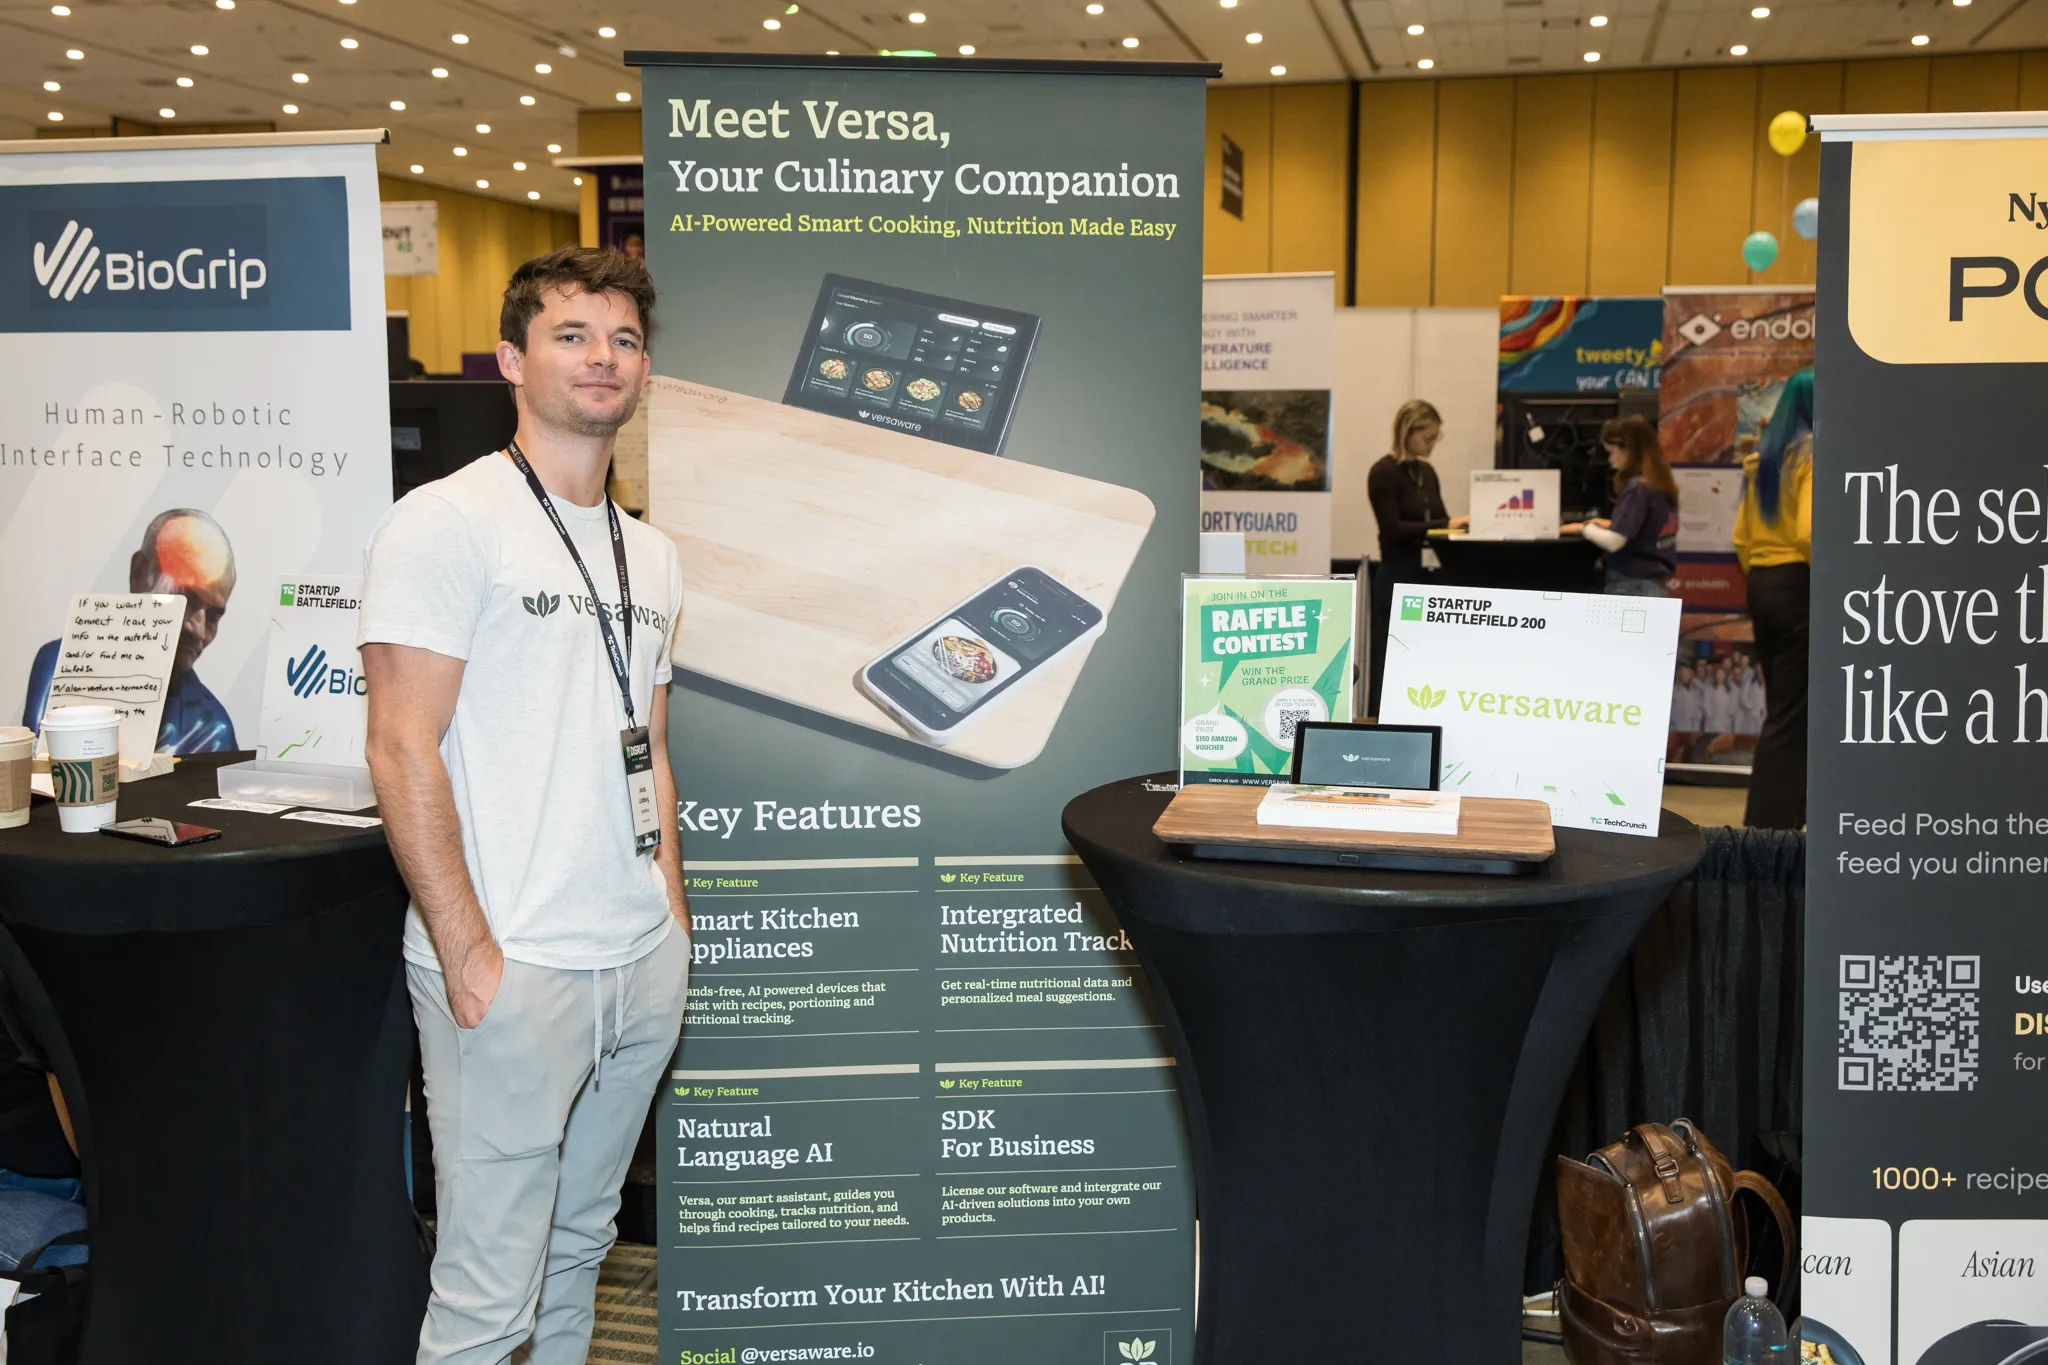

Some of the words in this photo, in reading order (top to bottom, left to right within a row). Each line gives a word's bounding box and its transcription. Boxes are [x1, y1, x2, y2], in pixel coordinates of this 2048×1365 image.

[669, 99, 789, 138] Meet
[803, 101, 949, 148] Versa,
[669, 161, 763, 192] Your
[775, 158, 944, 202] Culinary
[955, 163, 1179, 203] Companion
[670, 213, 792, 231] AI-Powered
[799, 215, 863, 232] Smart
[869, 215, 960, 238] Cooking,
[967, 216, 1064, 234] Nutrition
[1070, 217, 1124, 235] Made
[1130, 219, 1176, 240] Easy
[106, 248, 266, 299] BioGrip
[871, 413, 921, 432] versaware
[0, 443, 142, 467] Interface
[162, 444, 348, 476] Technology
[1845, 464, 1960, 545] The
[298, 585, 340, 595] STARTUP
[1212, 593, 1233, 601] JOIN
[1251, 590, 1264, 599] ON
[1268, 589, 1287, 597] THE
[116, 599, 143, 609] want
[152, 600, 162, 608] to
[297, 597, 356, 609] BATTLEFIELD
[1428, 597, 1492, 611] STARTUP
[1842, 574, 1998, 646] stove
[123, 616, 146, 626] leave
[152, 619, 173, 627] your
[1212, 606, 1306, 632] RAFFLE
[1426, 611, 1518, 628] BATTLEFIELD
[1521, 617, 1546, 630] 200
[107, 633, 118, 641] the
[1213, 632, 1307, 654] CONTEST
[1242, 667, 1262, 676] WIN
[1265, 667, 1285, 675] THE
[1242, 677, 1277, 686] GRAND
[1280, 675, 1309, 685] PRIZE
[1457, 690, 1642, 726] versaware
[1840, 664, 1948, 745] like
[1965, 688, 1998, 746] a
[1196, 735, 1209, 743] $150
[677, 800, 743, 839] Key
[754, 799, 921, 832] Features
[1604, 818, 1647, 830] TechCrunch
[1838, 813, 1906, 836] Feed
[1916, 812, 1999, 836] Posha
[2006, 812, 2048, 835] the
[1838, 851, 1901, 875] feed
[1909, 855, 1958, 880] you
[693, 878, 713, 889] Key
[717, 878, 758, 887] Feature
[960, 873, 980, 884] Key
[983, 873, 1023, 882] Feature
[692, 911, 753, 930] mart
[760, 906, 859, 930] Kitchen
[941, 903, 1083, 929] Intergrated
[690, 937, 813, 964] ppliances
[941, 931, 1058, 954] Nutrition
[942, 981, 961, 990] Get
[965, 979, 1016, 989] real-time
[1020, 978, 1081, 988] nutritional
[1084, 977, 1108, 987] data
[1111, 977, 1132, 987] and
[2015, 976, 2048, 995] Use
[941, 992, 1013, 1006] personalized
[1016, 992, 1043, 1002] meal
[1046, 991, 1115, 1004] suggestions.
[2014, 1051, 2045, 1071] for
[694, 1087, 714, 1098] Key
[717, 1087, 758, 1096] Feature
[959, 1079, 979, 1090] Key
[982, 1079, 1022, 1087] Feature
[678, 1116, 771, 1138] Natural
[942, 1110, 995, 1130] SDK
[942, 1139, 982, 1158] For
[989, 1135, 1094, 1156] Business
[678, 1147, 799, 1171] Language
[806, 1143, 832, 1162] AI
[1873, 1167, 1957, 1190] 1000+
[679, 1196, 714, 1206] Versa,
[717, 1197, 737, 1205] our
[740, 1194, 773, 1204] smart
[776, 1192, 830, 1202] assistant,
[834, 1189, 871, 1202] guides
[874, 1191, 894, 1201] you
[942, 1186, 984, 1196] License
[1009, 1184, 1058, 1194] software
[1061, 1182, 1081, 1192] and
[1084, 1182, 1140, 1193] intergrate
[1143, 1182, 1161, 1190] our
[679, 1209, 726, 1221] through
[729, 1207, 777, 1219] cooking,
[781, 1205, 816, 1216] tracks
[819, 1203, 874, 1214] nutrition,
[877, 1202, 898, 1212] and
[942, 1199, 995, 1210] AI-driven
[998, 1197, 1050, 1208] solutions
[1053, 1196, 1076, 1207] into
[1078, 1197, 1104, 1209] your
[1106, 1196, 1131, 1206] own
[679, 1223, 710, 1235] helps
[713, 1222, 735, 1232] find
[738, 1221, 779, 1233] recipes
[782, 1218, 826, 1229] tailored
[829, 1219, 842, 1227] to
[844, 1219, 871, 1229] your
[873, 1215, 909, 1226] needs.
[942, 1213, 995, 1225] products.
[1962, 1250, 2036, 1278] Asian
[677, 1286, 817, 1312] Transform
[824, 1283, 886, 1307] Your
[892, 1277, 994, 1303] Kitchen
[1000, 1275, 1064, 1299] With
[1070, 1274, 1106, 1296] AI!
[681, 1347, 736, 1365] Social
[741, 1342, 875, 1365] @versaware.io
